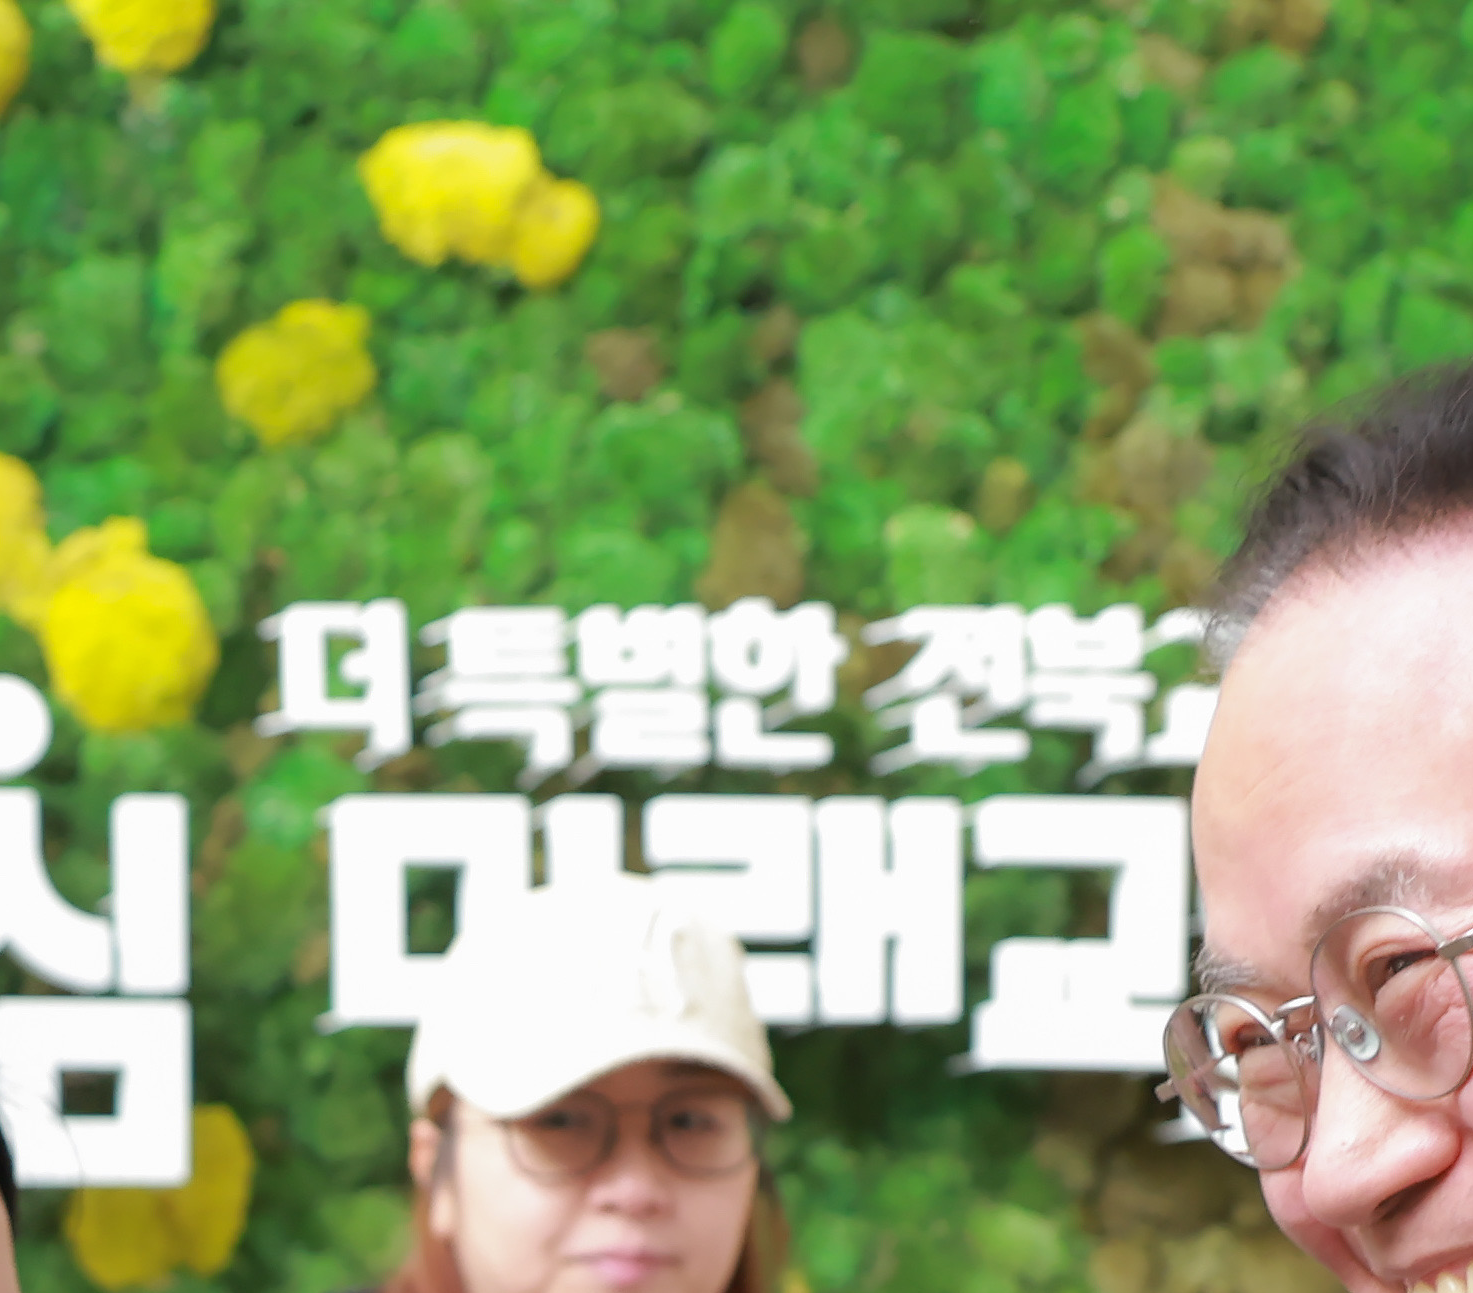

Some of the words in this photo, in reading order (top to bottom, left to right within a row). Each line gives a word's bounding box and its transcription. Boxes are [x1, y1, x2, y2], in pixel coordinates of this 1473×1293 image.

[258, 598, 411, 770] 더
[416, 598, 848, 785] 특별한
[317, 792, 1194, 1072] 미래교
